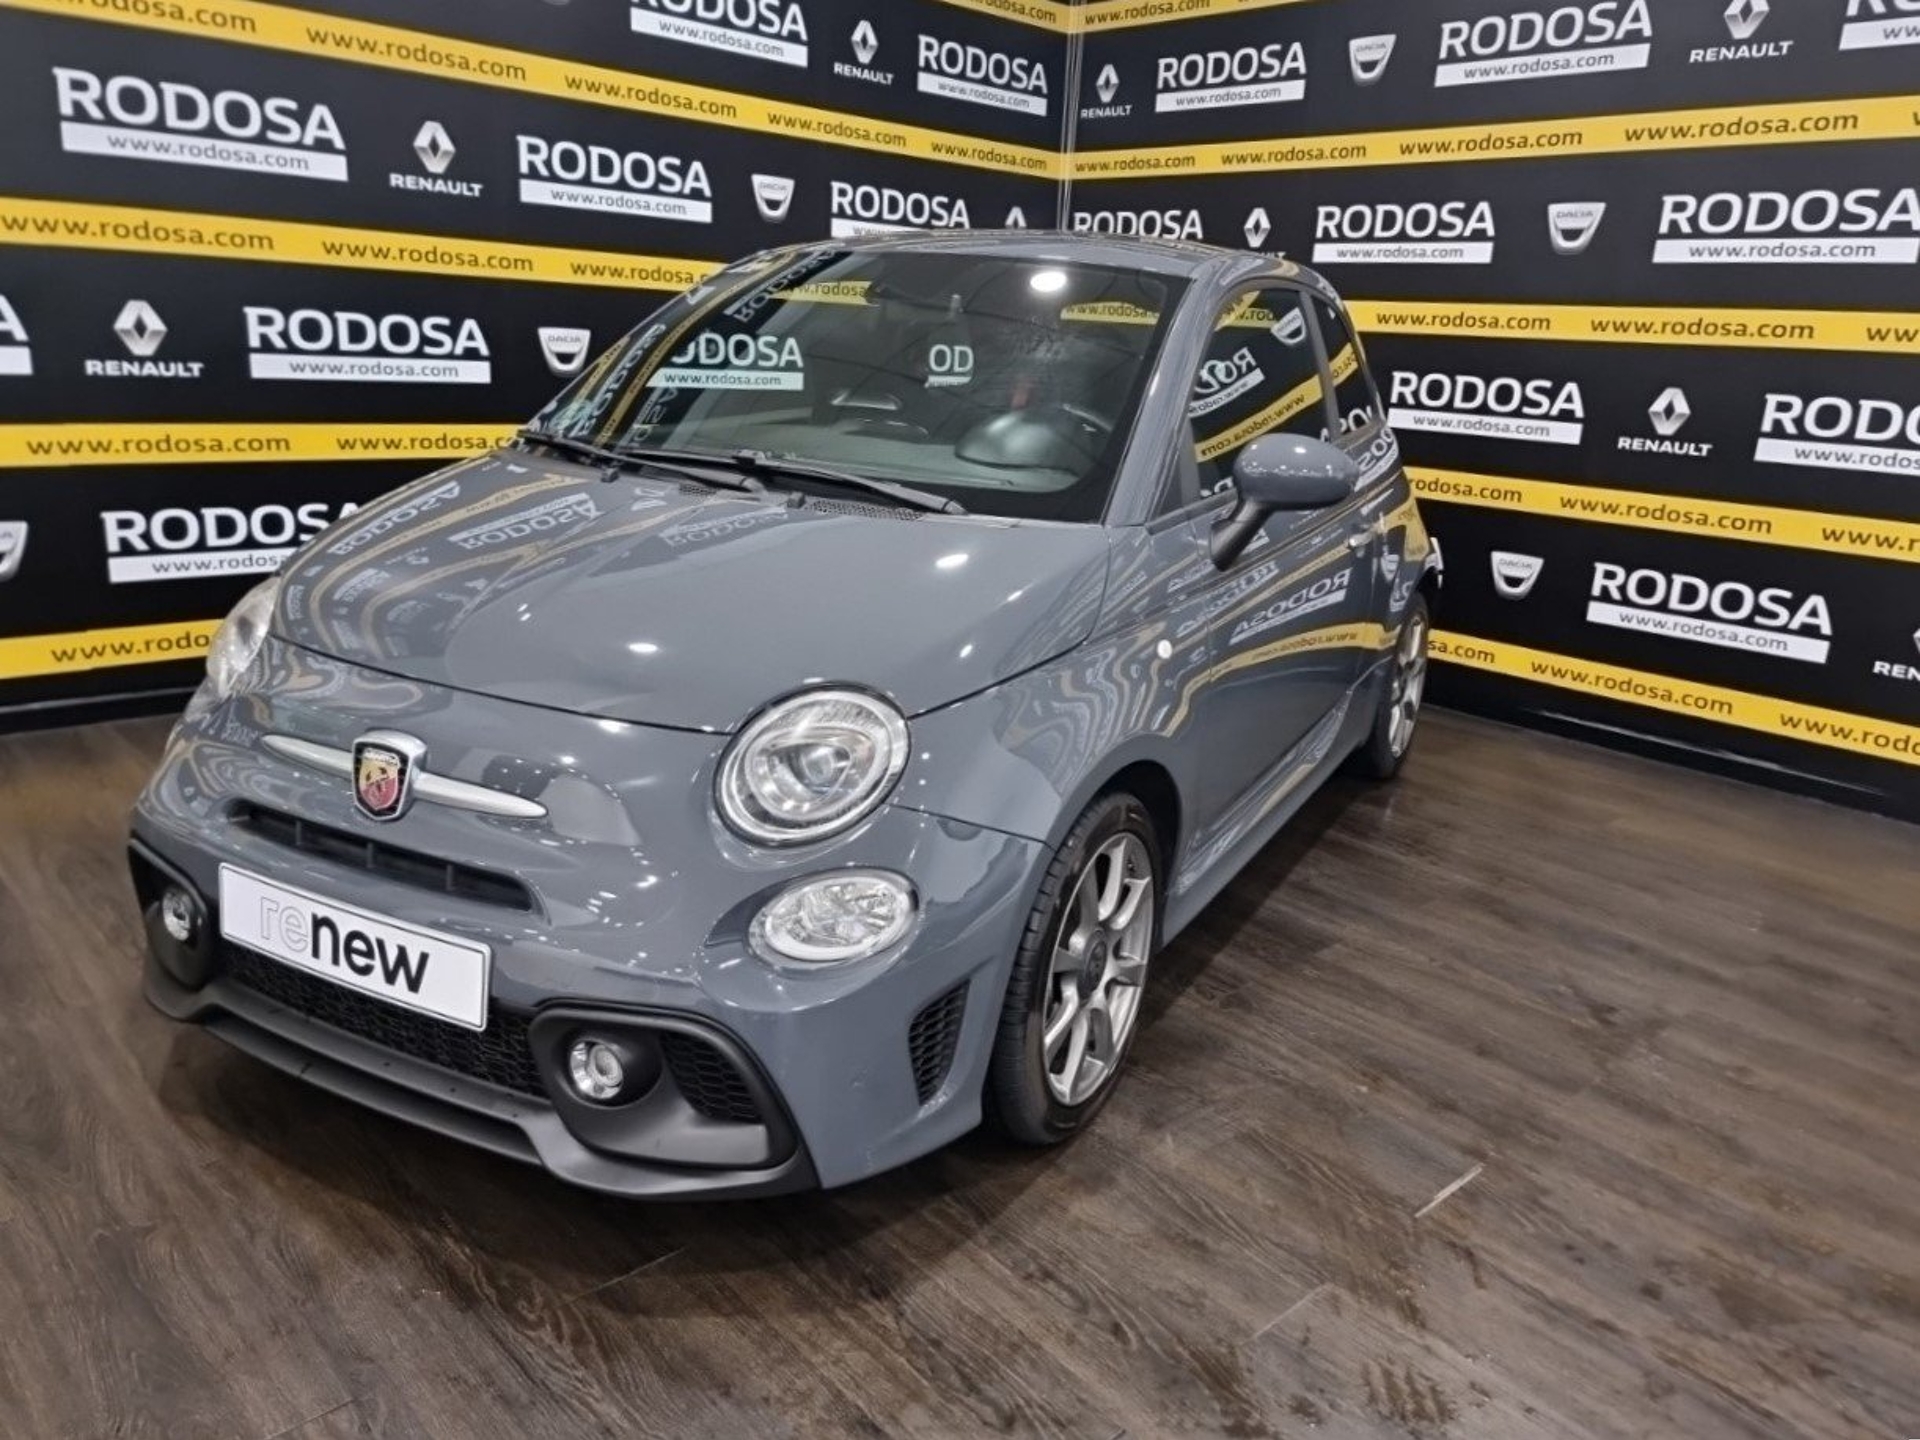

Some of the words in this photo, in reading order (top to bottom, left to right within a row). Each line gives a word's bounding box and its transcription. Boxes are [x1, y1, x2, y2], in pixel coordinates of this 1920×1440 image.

[659, 20, 784, 57] www.rodosa.com
[1439, 0, 1652, 60] RODOSA
[307, 26, 526, 81] www.rodosa.com
[918, 35, 1047, 94] RODOSA
[1157, 42, 1306, 89] RODOSA
[1464, 52, 1614, 79] www.rodosa.com
[1689, 41, 1793, 63] RENAULT
[834, 63, 893, 85] RENAULT
[52, 66, 345, 150] RODOSA
[564, 74, 737, 119] www.rodosa.com
[938, 80, 1030, 109] www.rodosa.com
[1176, 86, 1281, 106] www.rodosa.com
[1081, 105, 1133, 119] RENAULT
[767, 112, 907, 147] www.rodosa.com
[1624, 113, 1859, 142] www.rodosa.com
[107, 134, 310, 171] www.rodosa.com
[931, 141, 1047, 170] www.rodosa.com
[1221, 144, 1367, 165] www.rodosa.com
[1400, 133, 1583, 156] www.rodosa.com
[517, 135, 712, 197] RODOSA
[1075, 153, 1195, 173] www.rodosa.com
[390, 173, 483, 198] RENAULT
[550, 187, 687, 216] www.rodosa.com
[831, 181, 970, 229] RODOSA
[1658, 188, 1920, 232] RODOSA
[1, 213, 274, 250] www.rodosa.com
[1074, 209, 1204, 240] RODOSA
[1316, 202, 1495, 238] RODOSA
[322, 240, 533, 271] www.rodosa.com
[1336, 246, 1464, 258] www.rodosa.com
[1689, 242, 1876, 257] www.rodosa.com
[243, 306, 490, 356] RODOSA
[1376, 310, 1551, 330] www.rodosa.com
[1590, 317, 1815, 339] www.rodosa.com
[86, 360, 203, 377] RENAULT
[289, 361, 459, 378] www.rodosa.com
[664, 371, 782, 387] www.rodosa.com
[1391, 371, 1584, 418] RODOSA
[1413, 414, 1550, 437] www.rodosa.com
[26, 434, 291, 456] www.rodosa.com
[1617, 437, 1712, 456] RENAULT
[1560, 494, 1773, 534] www.rodosa.com
[1591, 562, 1833, 636] RODOSA
[1618, 610, 1788, 652] www.rodosa.com
[1530, 658, 1733, 716] www.rodosa.com
[259, 896, 430, 994] renew
